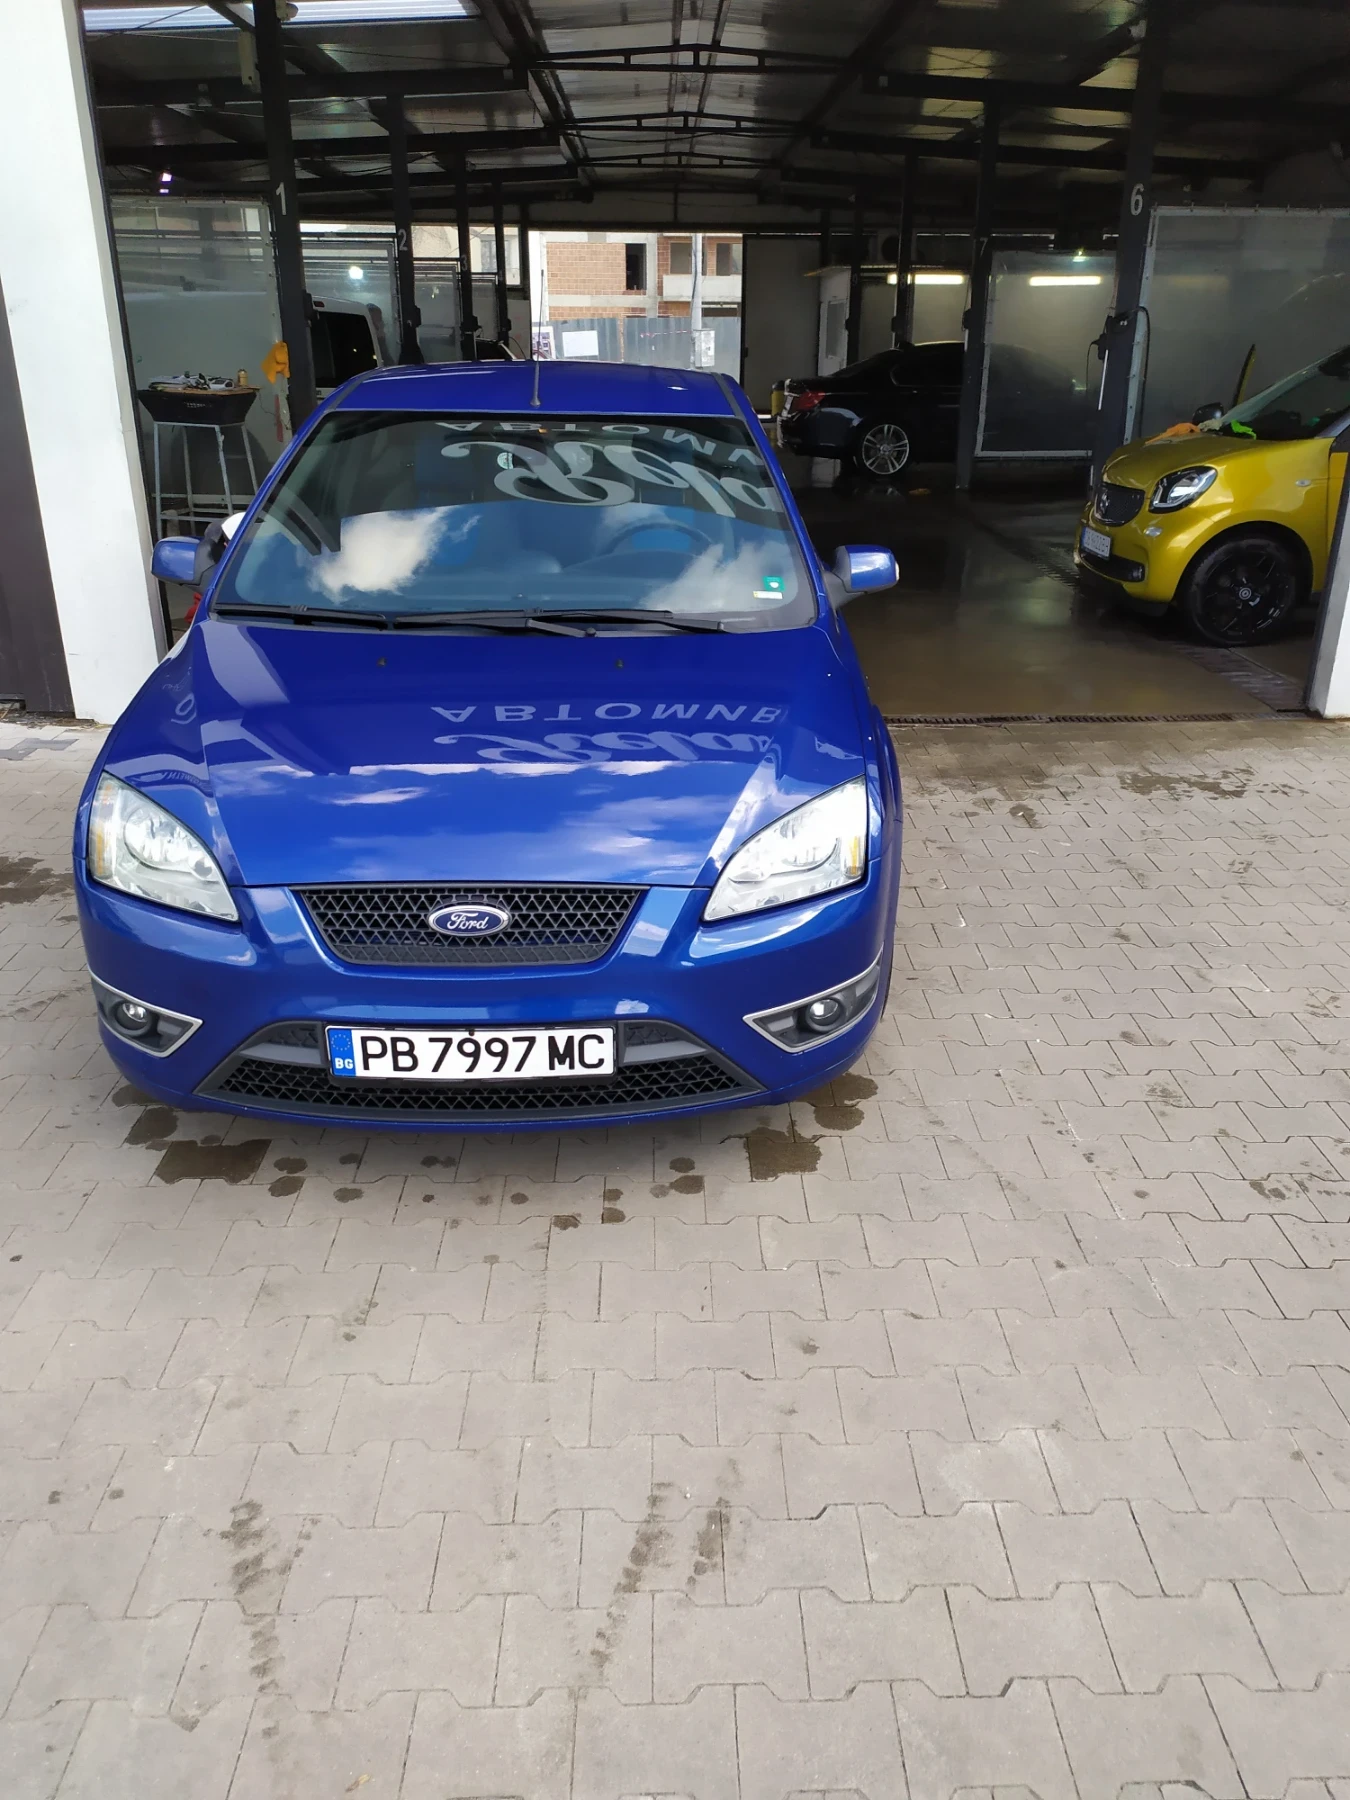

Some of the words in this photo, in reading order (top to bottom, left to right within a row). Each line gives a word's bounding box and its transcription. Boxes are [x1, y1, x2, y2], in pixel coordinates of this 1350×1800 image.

[275, 182, 287, 216] 1
[1130, 183, 1145, 216] 6
[398, 229, 408, 251] 2
[979, 237, 989, 257] 7
[460, 254, 468, 271] 3
[447, 912, 489, 930] Ford
[334, 1057, 354, 1070] BG
[360, 1036, 419, 1071] PB
[428, 1037, 536, 1073] 7997
[548, 1034, 605, 1071] MC
